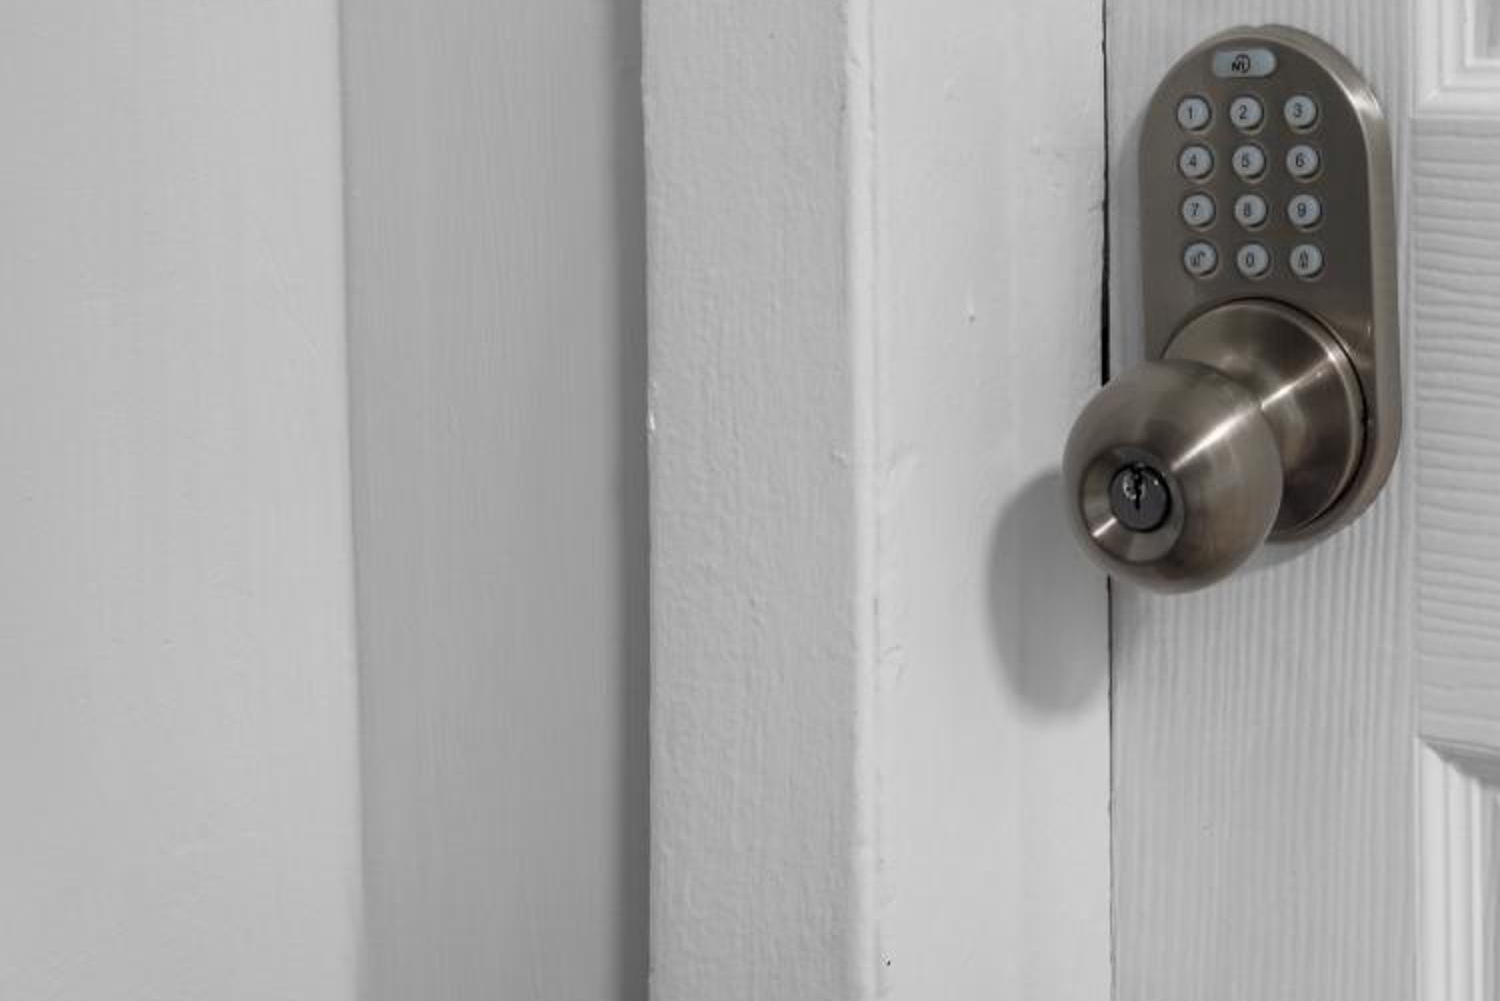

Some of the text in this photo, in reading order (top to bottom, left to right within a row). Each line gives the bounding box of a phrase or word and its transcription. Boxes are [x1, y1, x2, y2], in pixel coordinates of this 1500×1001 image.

[1239, 104, 1248, 119] 2
[1293, 102, 1303, 118] 3
[1188, 153, 1305, 168] 4 5 6
[1191, 202, 1307, 218] 7 8 9
[1245, 252, 1255, 268] 0
